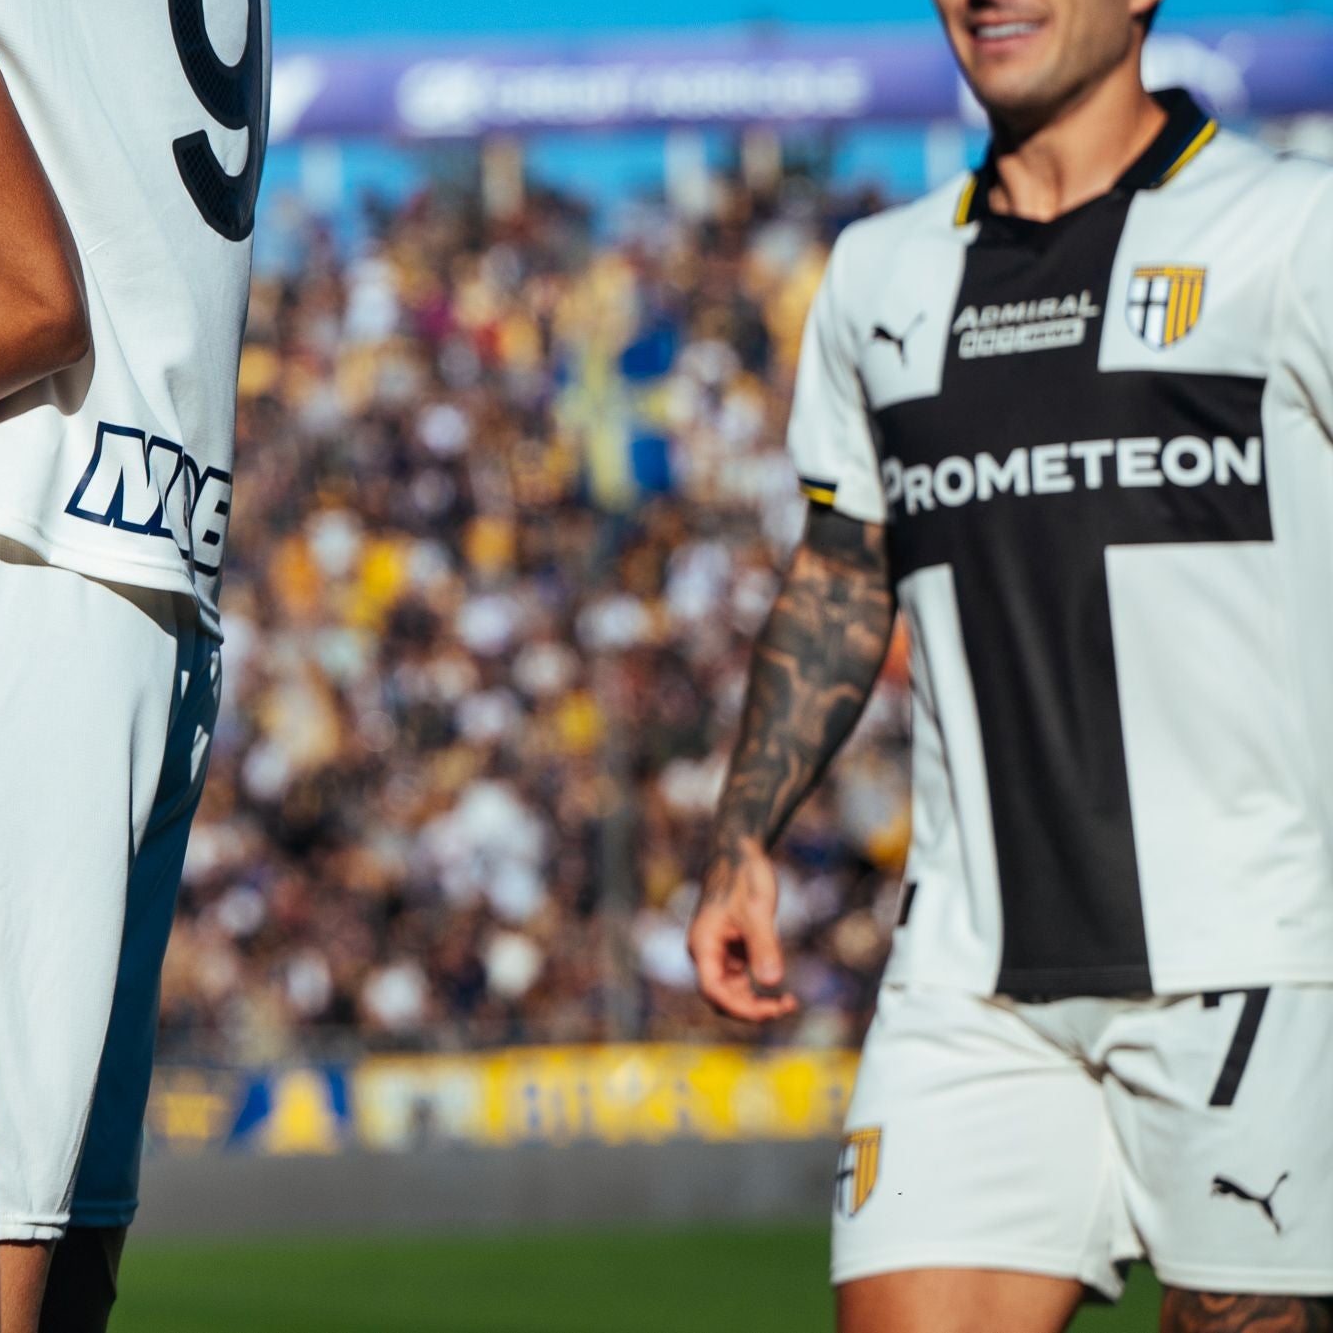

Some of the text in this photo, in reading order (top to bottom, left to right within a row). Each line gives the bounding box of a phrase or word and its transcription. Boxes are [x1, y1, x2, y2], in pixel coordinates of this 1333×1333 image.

[952, 289, 1101, 336] ADMIRAL
[881, 435, 1263, 517] PROMETEON
[1202, 986, 1271, 1107] 7
